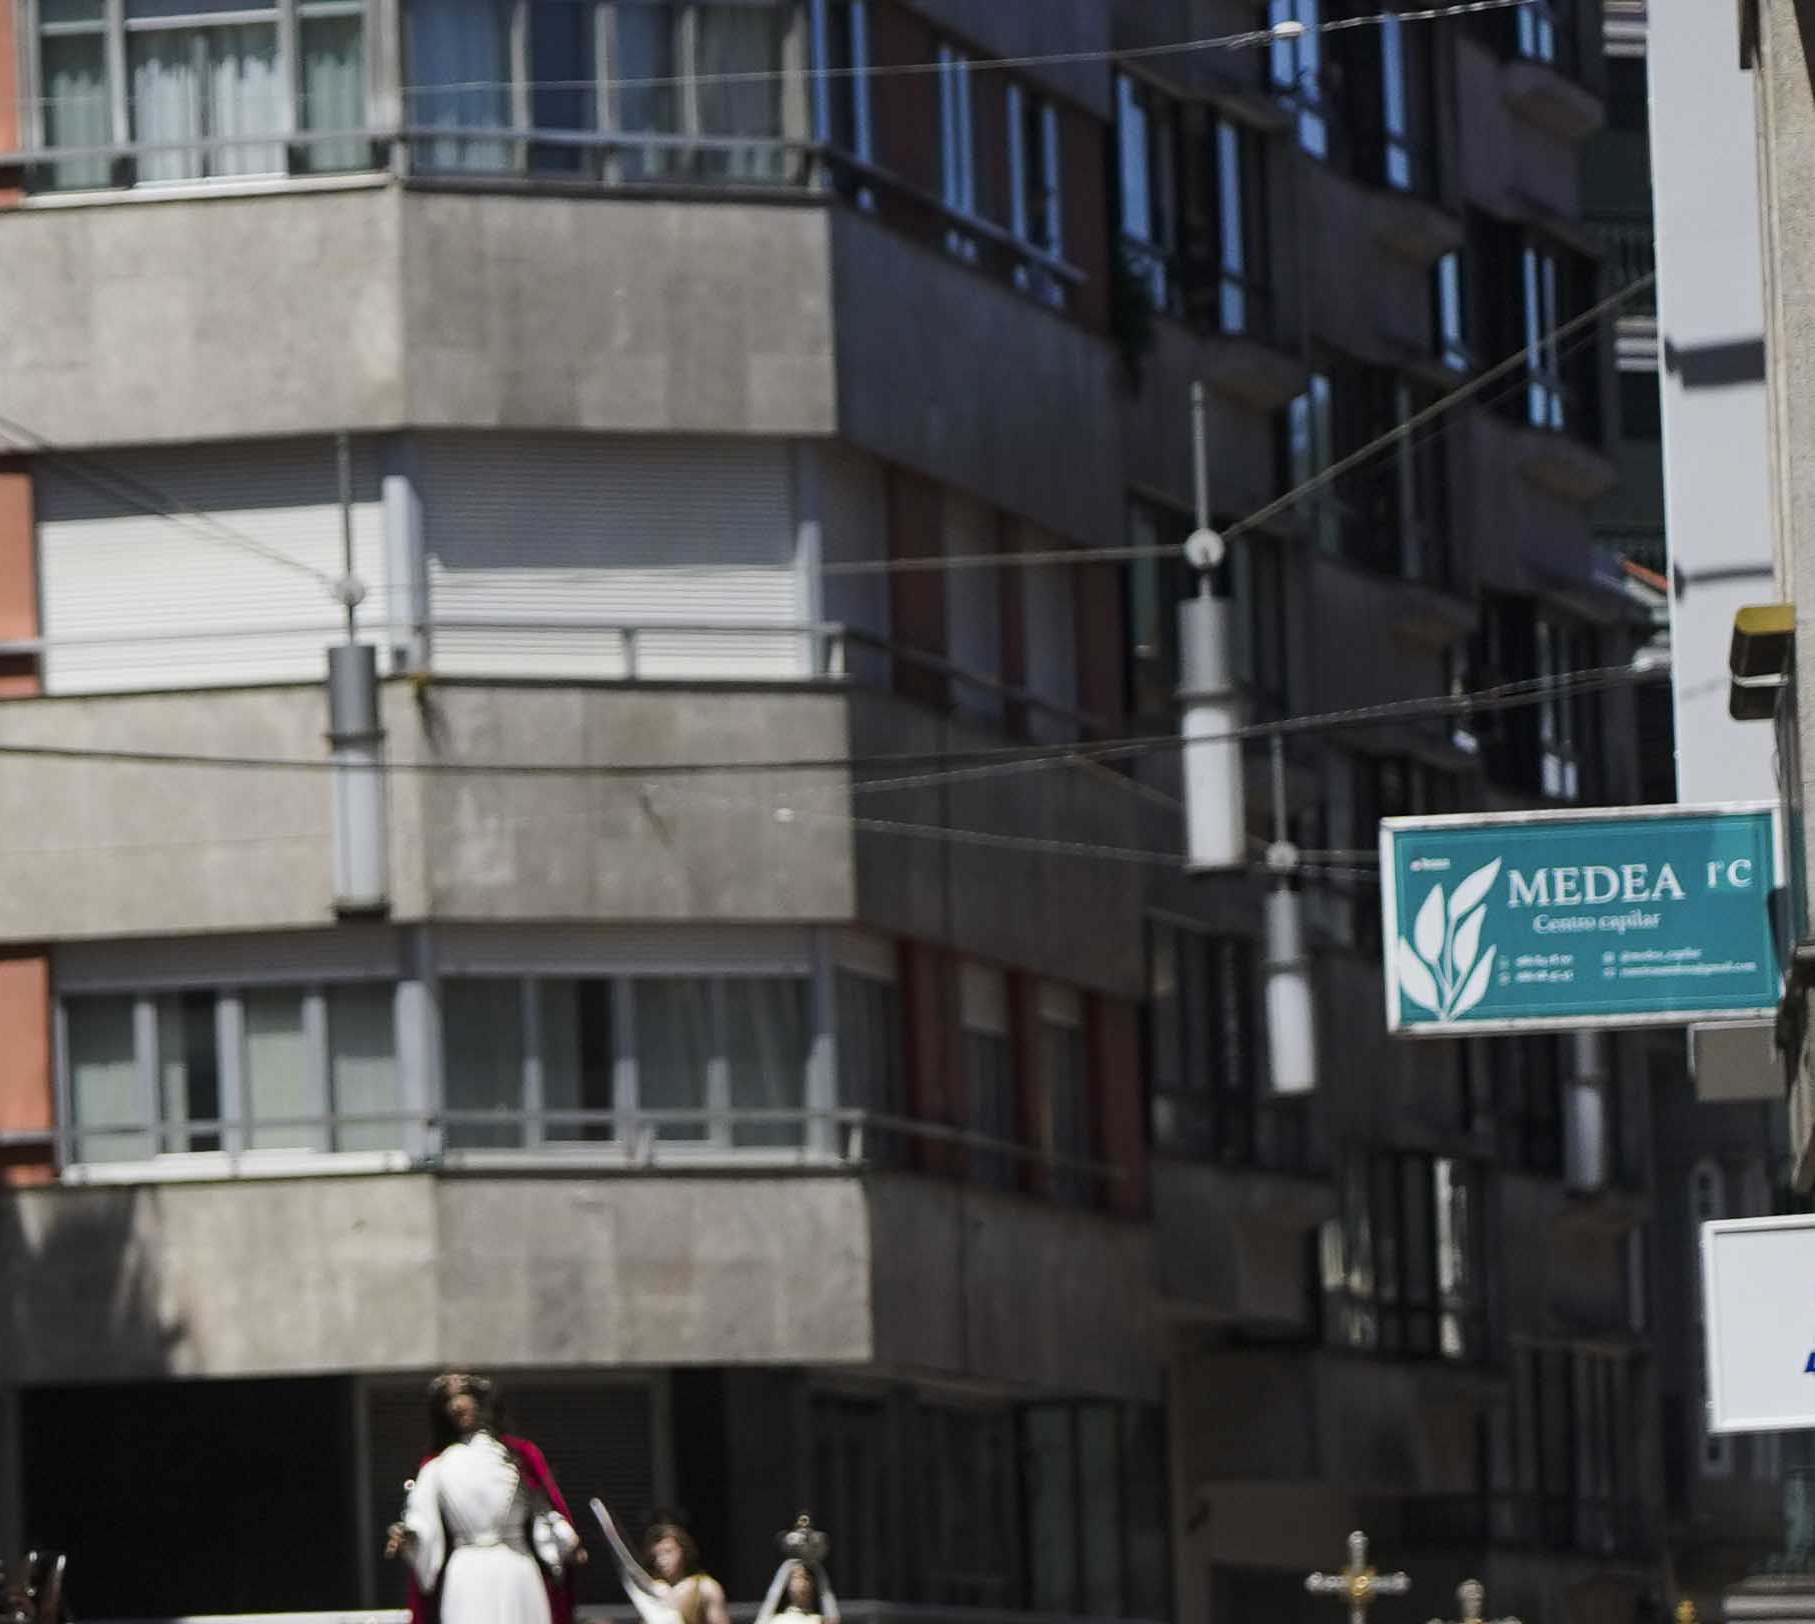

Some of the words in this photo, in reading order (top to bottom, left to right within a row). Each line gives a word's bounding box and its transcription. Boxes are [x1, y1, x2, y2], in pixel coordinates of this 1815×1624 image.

[1507, 861, 1687, 908] MEDEA
[1532, 913, 1596, 934] Centro
[1597, 908, 1662, 935] capilar
